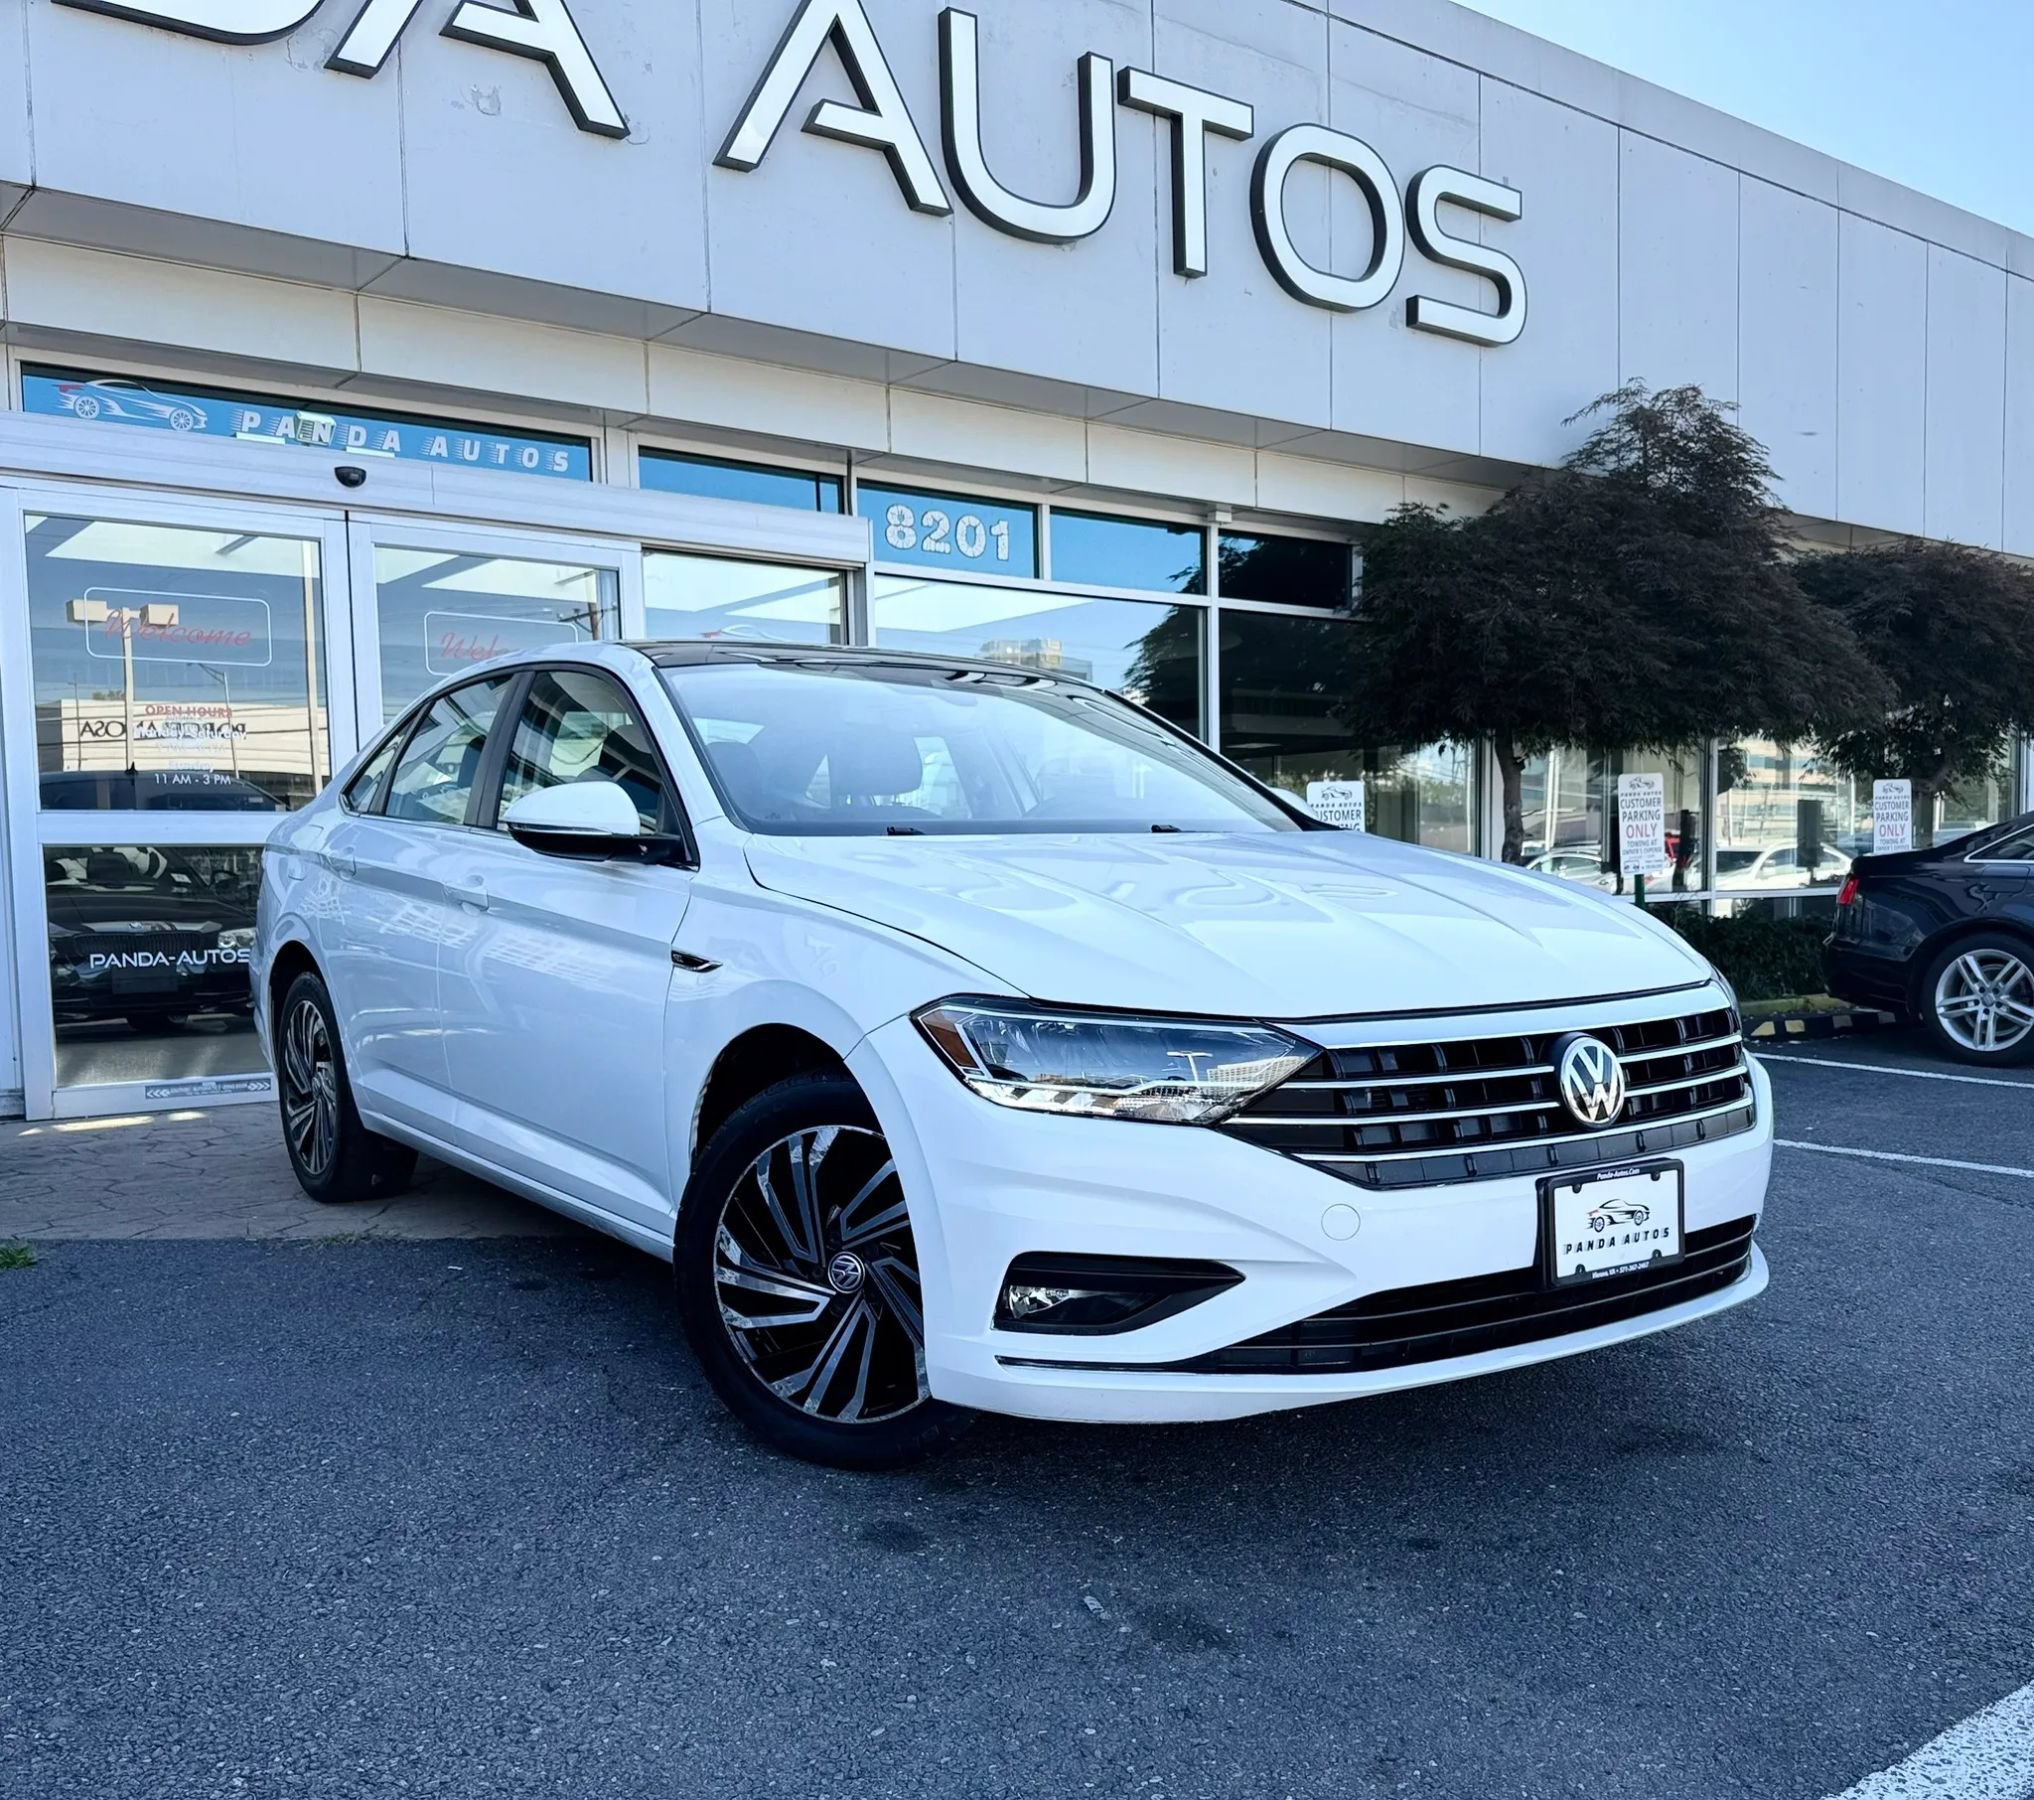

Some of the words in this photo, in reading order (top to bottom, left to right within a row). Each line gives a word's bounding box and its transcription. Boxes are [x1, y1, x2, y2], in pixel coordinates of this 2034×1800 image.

[712, 0, 1528, 347] AUTOS
[235, 408, 401, 452] PANDA
[426, 435, 569, 472] AUTOS
[885, 503, 1010, 561] 8201
[105, 608, 252, 646] Welcome
[145, 704, 182, 716] OPEN
[190, 705, 233, 718] HOURS
[154, 773, 167, 784] 11
[172, 774, 192, 785] AM
[203, 773, 210, 785] 3
[214, 774, 232, 785] PM
[1620, 798, 1662, 809] CUSTOMER
[1875, 801, 1909, 811] CUSTOMER
[1622, 810, 1661, 822] PARKING
[1876, 811, 1909, 822] PARKING
[1626, 823, 1657, 839] ONLY
[1879, 824, 1906, 837] ONLY
[89, 949, 251, 968] PANDA-AUTOS
[1564, 1236, 1616, 1255] PANDA
[1622, 1227, 1670, 1246] AUTOS
